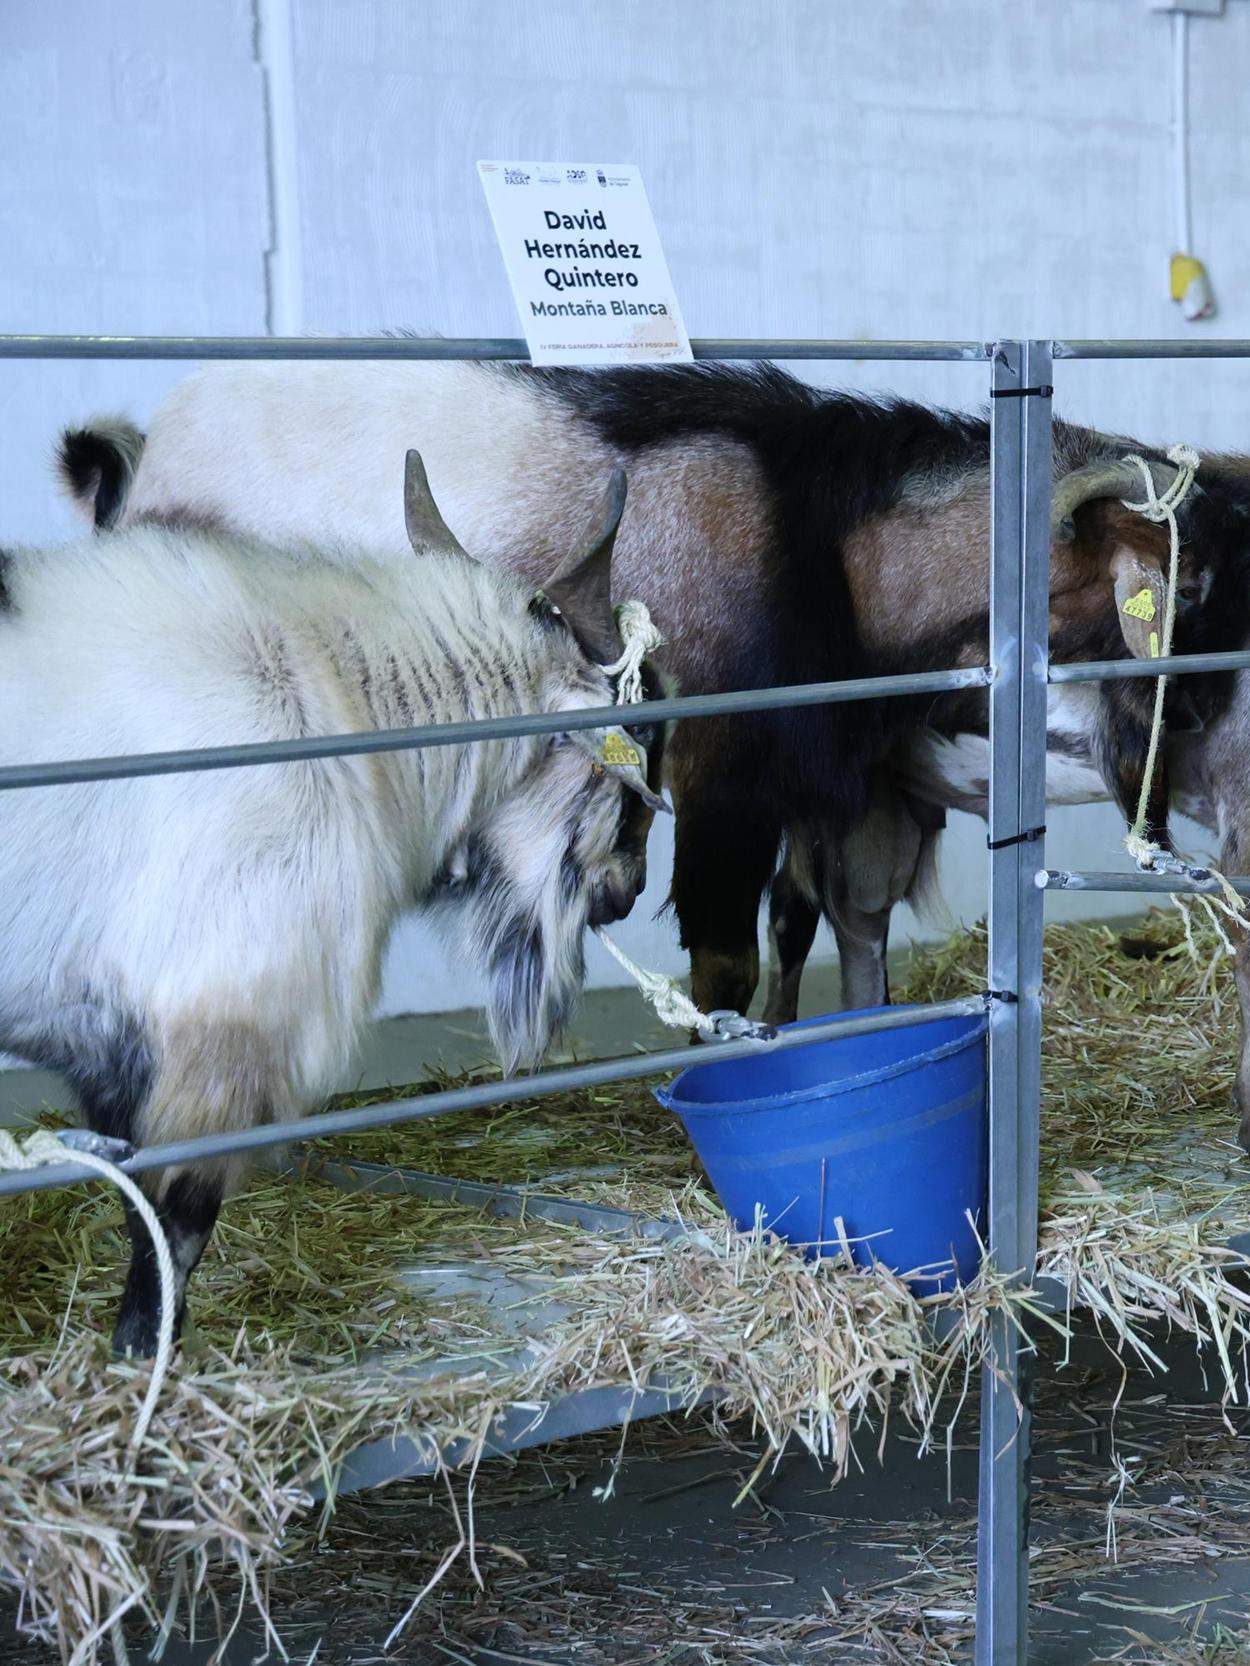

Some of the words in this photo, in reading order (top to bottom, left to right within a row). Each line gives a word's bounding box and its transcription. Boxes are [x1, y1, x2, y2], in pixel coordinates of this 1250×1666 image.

[544, 208, 607, 230] David
[524, 238, 642, 259] Hernández
[544, 266, 639, 291] Quintero
[530, 299, 607, 317] Montaña
[610, 300, 668, 316] Blanca
